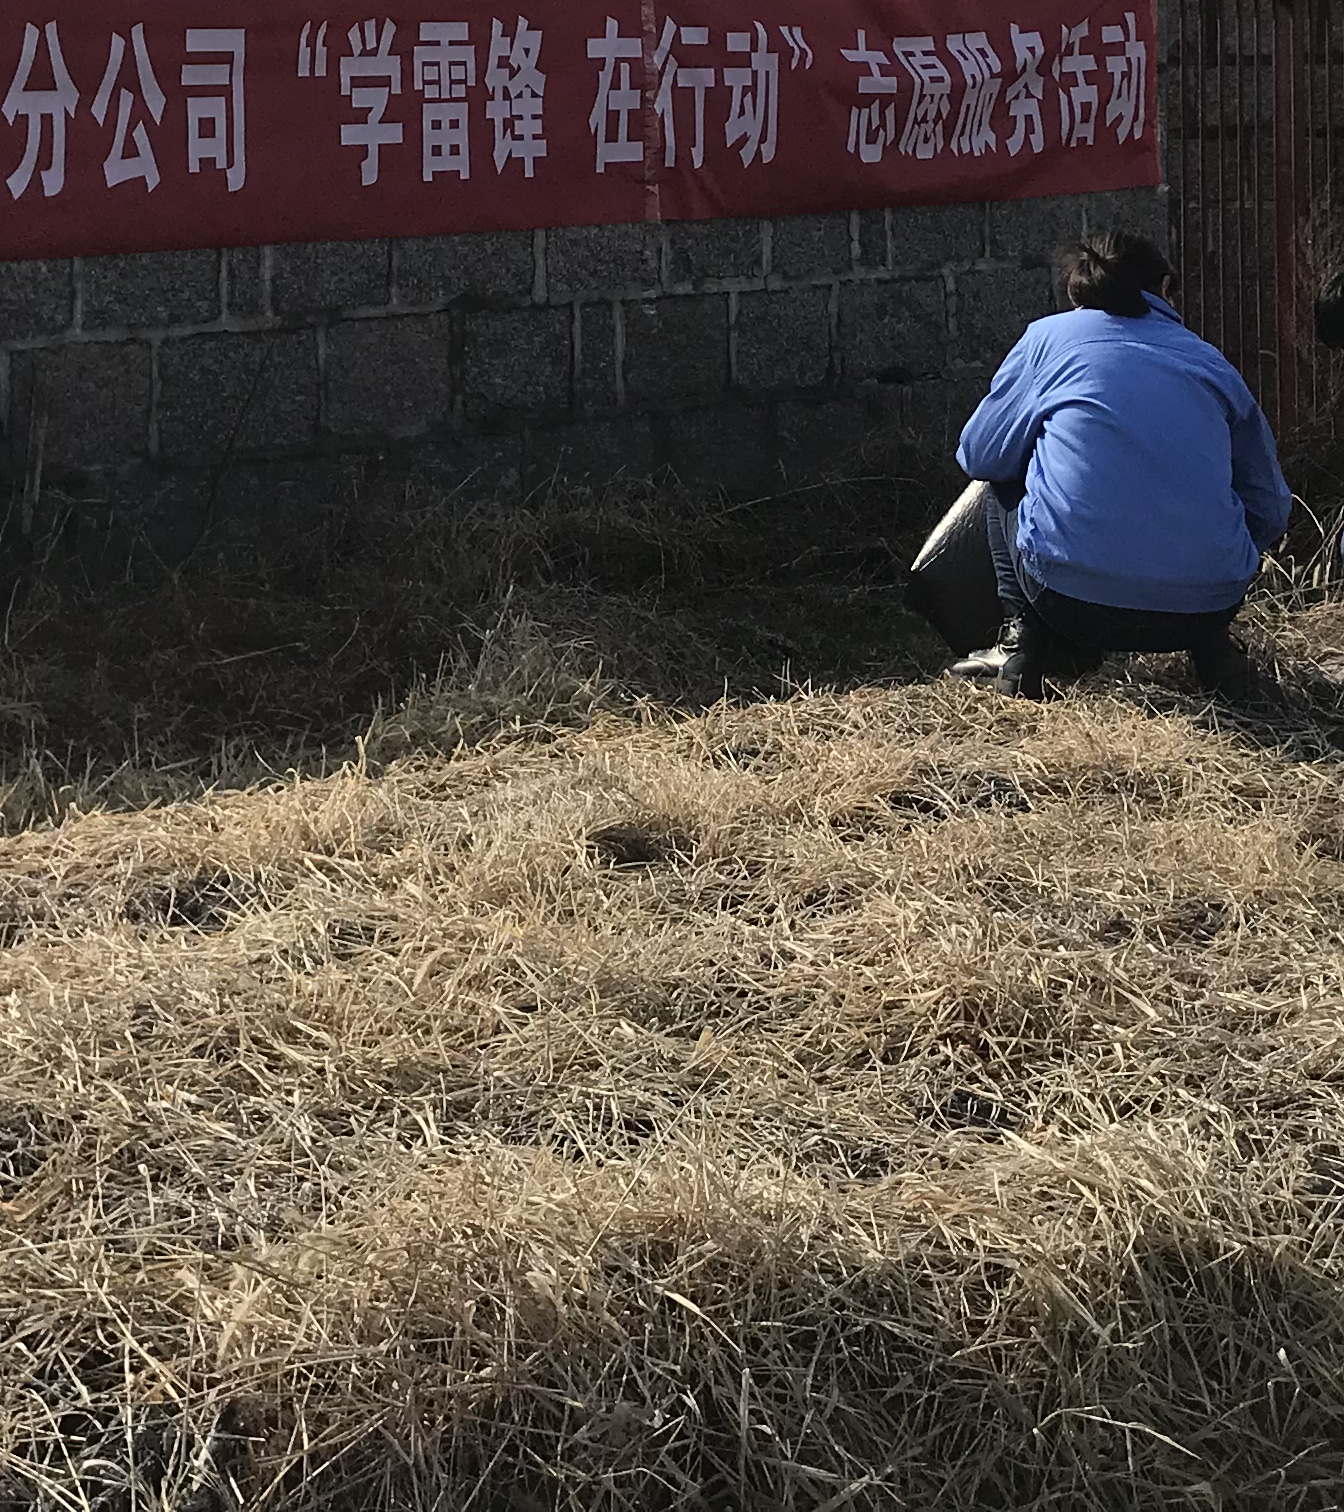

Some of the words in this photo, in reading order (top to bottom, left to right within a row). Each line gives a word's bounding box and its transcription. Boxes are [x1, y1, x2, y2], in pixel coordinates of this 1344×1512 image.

[297, 16, 547, 186] “学雷锋
[586, 15, 813, 173] 在行动”
[839, 11, 1147, 164] 志愿服务活动
